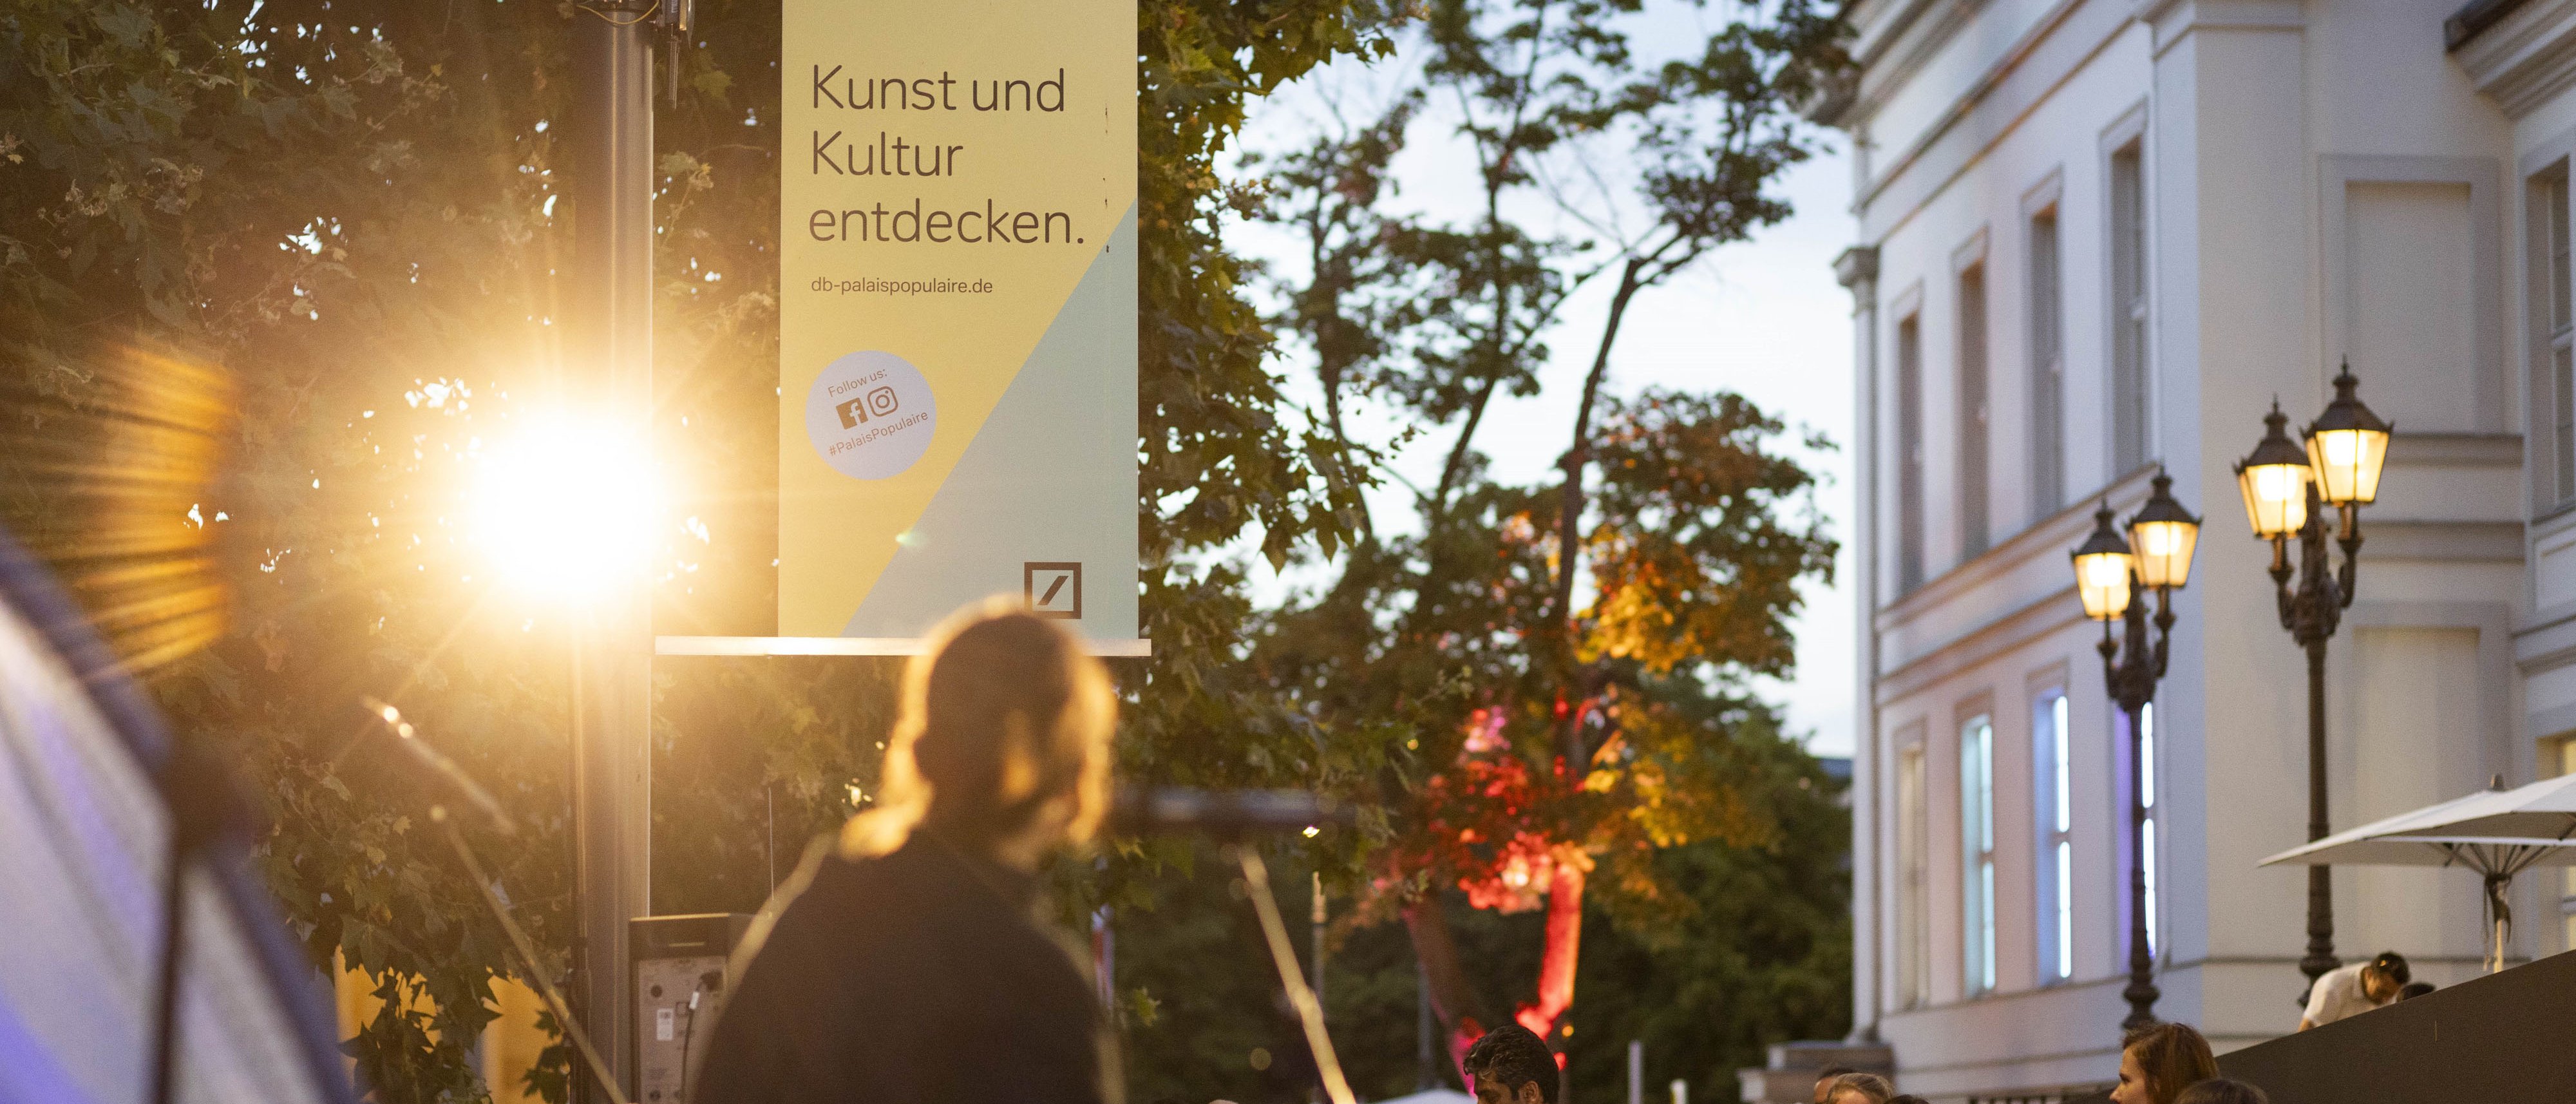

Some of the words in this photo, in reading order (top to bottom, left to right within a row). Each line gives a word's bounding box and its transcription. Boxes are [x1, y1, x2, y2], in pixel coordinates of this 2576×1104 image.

[813, 64, 957, 111] Kunst
[972, 68, 1065, 112] und
[813, 130, 964, 176] Kultur
[809, 198, 1084, 244] entdecken.
[811, 277, 993, 296] db-palaispopulaire.de
[828, 377, 867, 397] Follow
[869, 369, 887, 381] us:
[829, 412, 929, 457] #PalaisPopulaire
